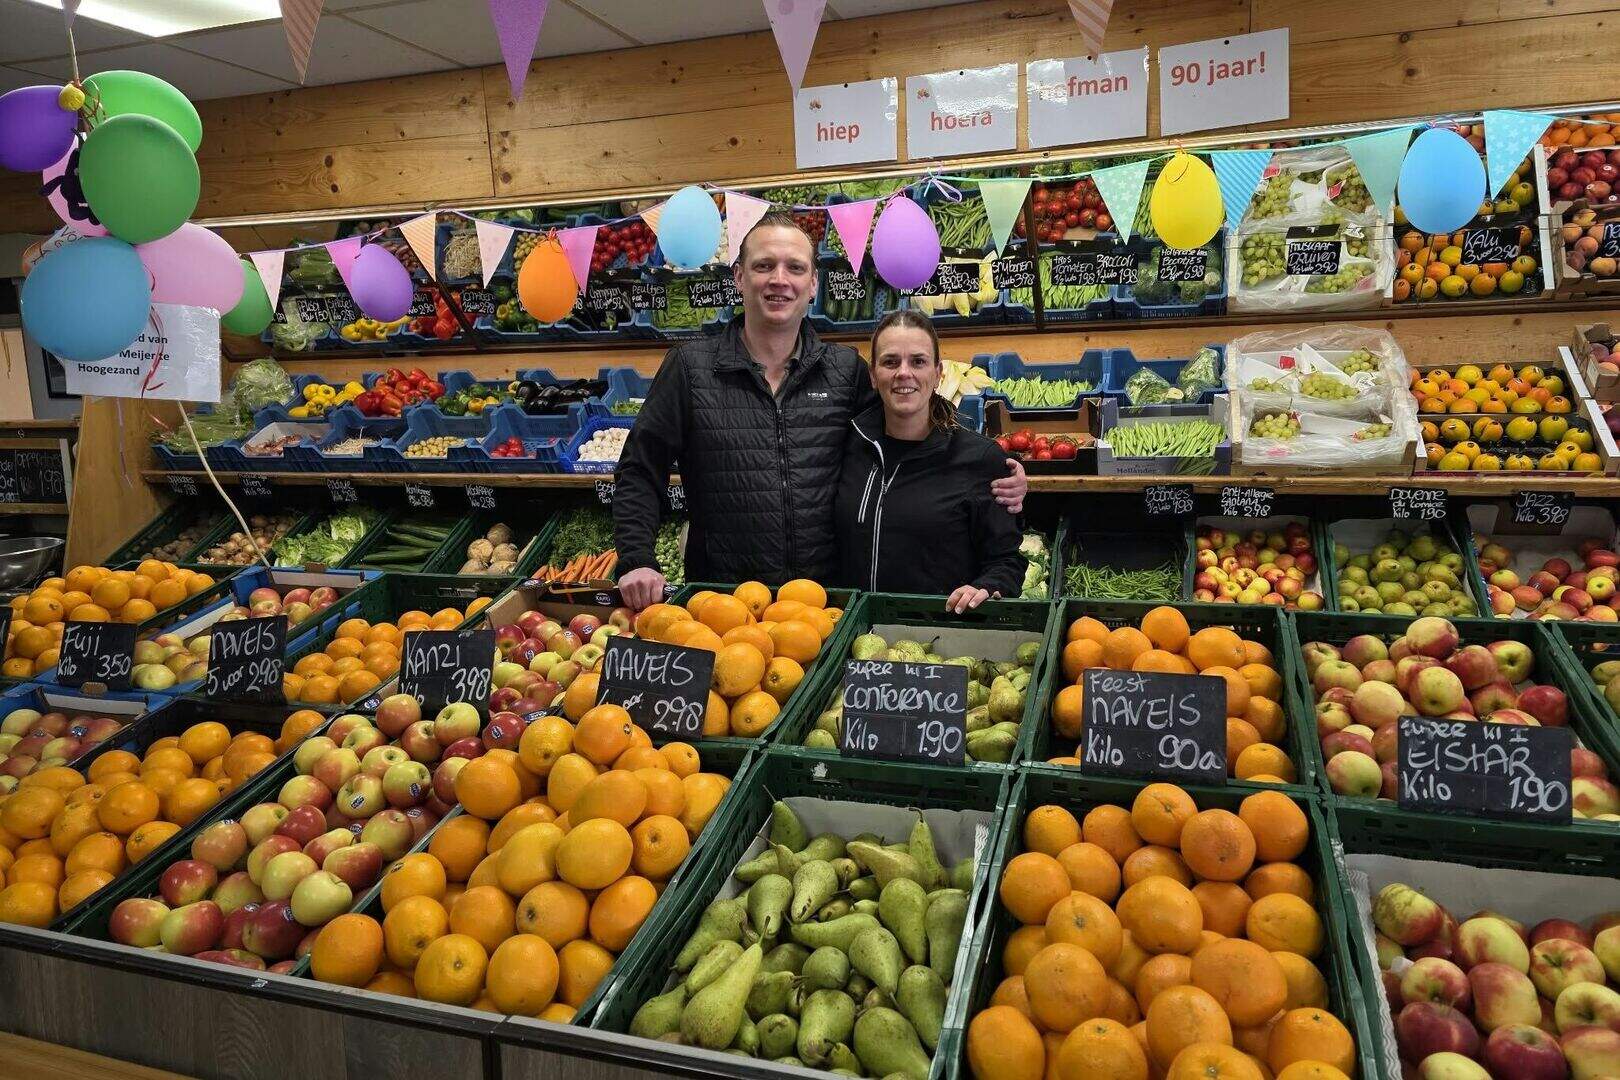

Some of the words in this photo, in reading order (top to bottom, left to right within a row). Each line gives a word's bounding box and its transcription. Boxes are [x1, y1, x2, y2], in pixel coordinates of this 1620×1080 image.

[1171, 62, 1203, 87] 90
[1205, 51, 1267, 87] jaar!
[1039, 75, 1129, 101] fman
[816, 119, 861, 144] hiep
[930, 104, 993, 132] hoera
[148, 335, 168, 344] van
[78, 363, 140, 376] Hoogezand
[63, 624, 104, 658] Fuji
[206, 666, 221, 696] 5
[848, 660, 894, 680] super
[1089, 672, 1152, 693] Feest
[843, 682, 967, 713] Conference
[845, 717, 879, 751] Kilo
[1085, 727, 1124, 766] Kilo
[1402, 769, 1452, 801] Kilo
